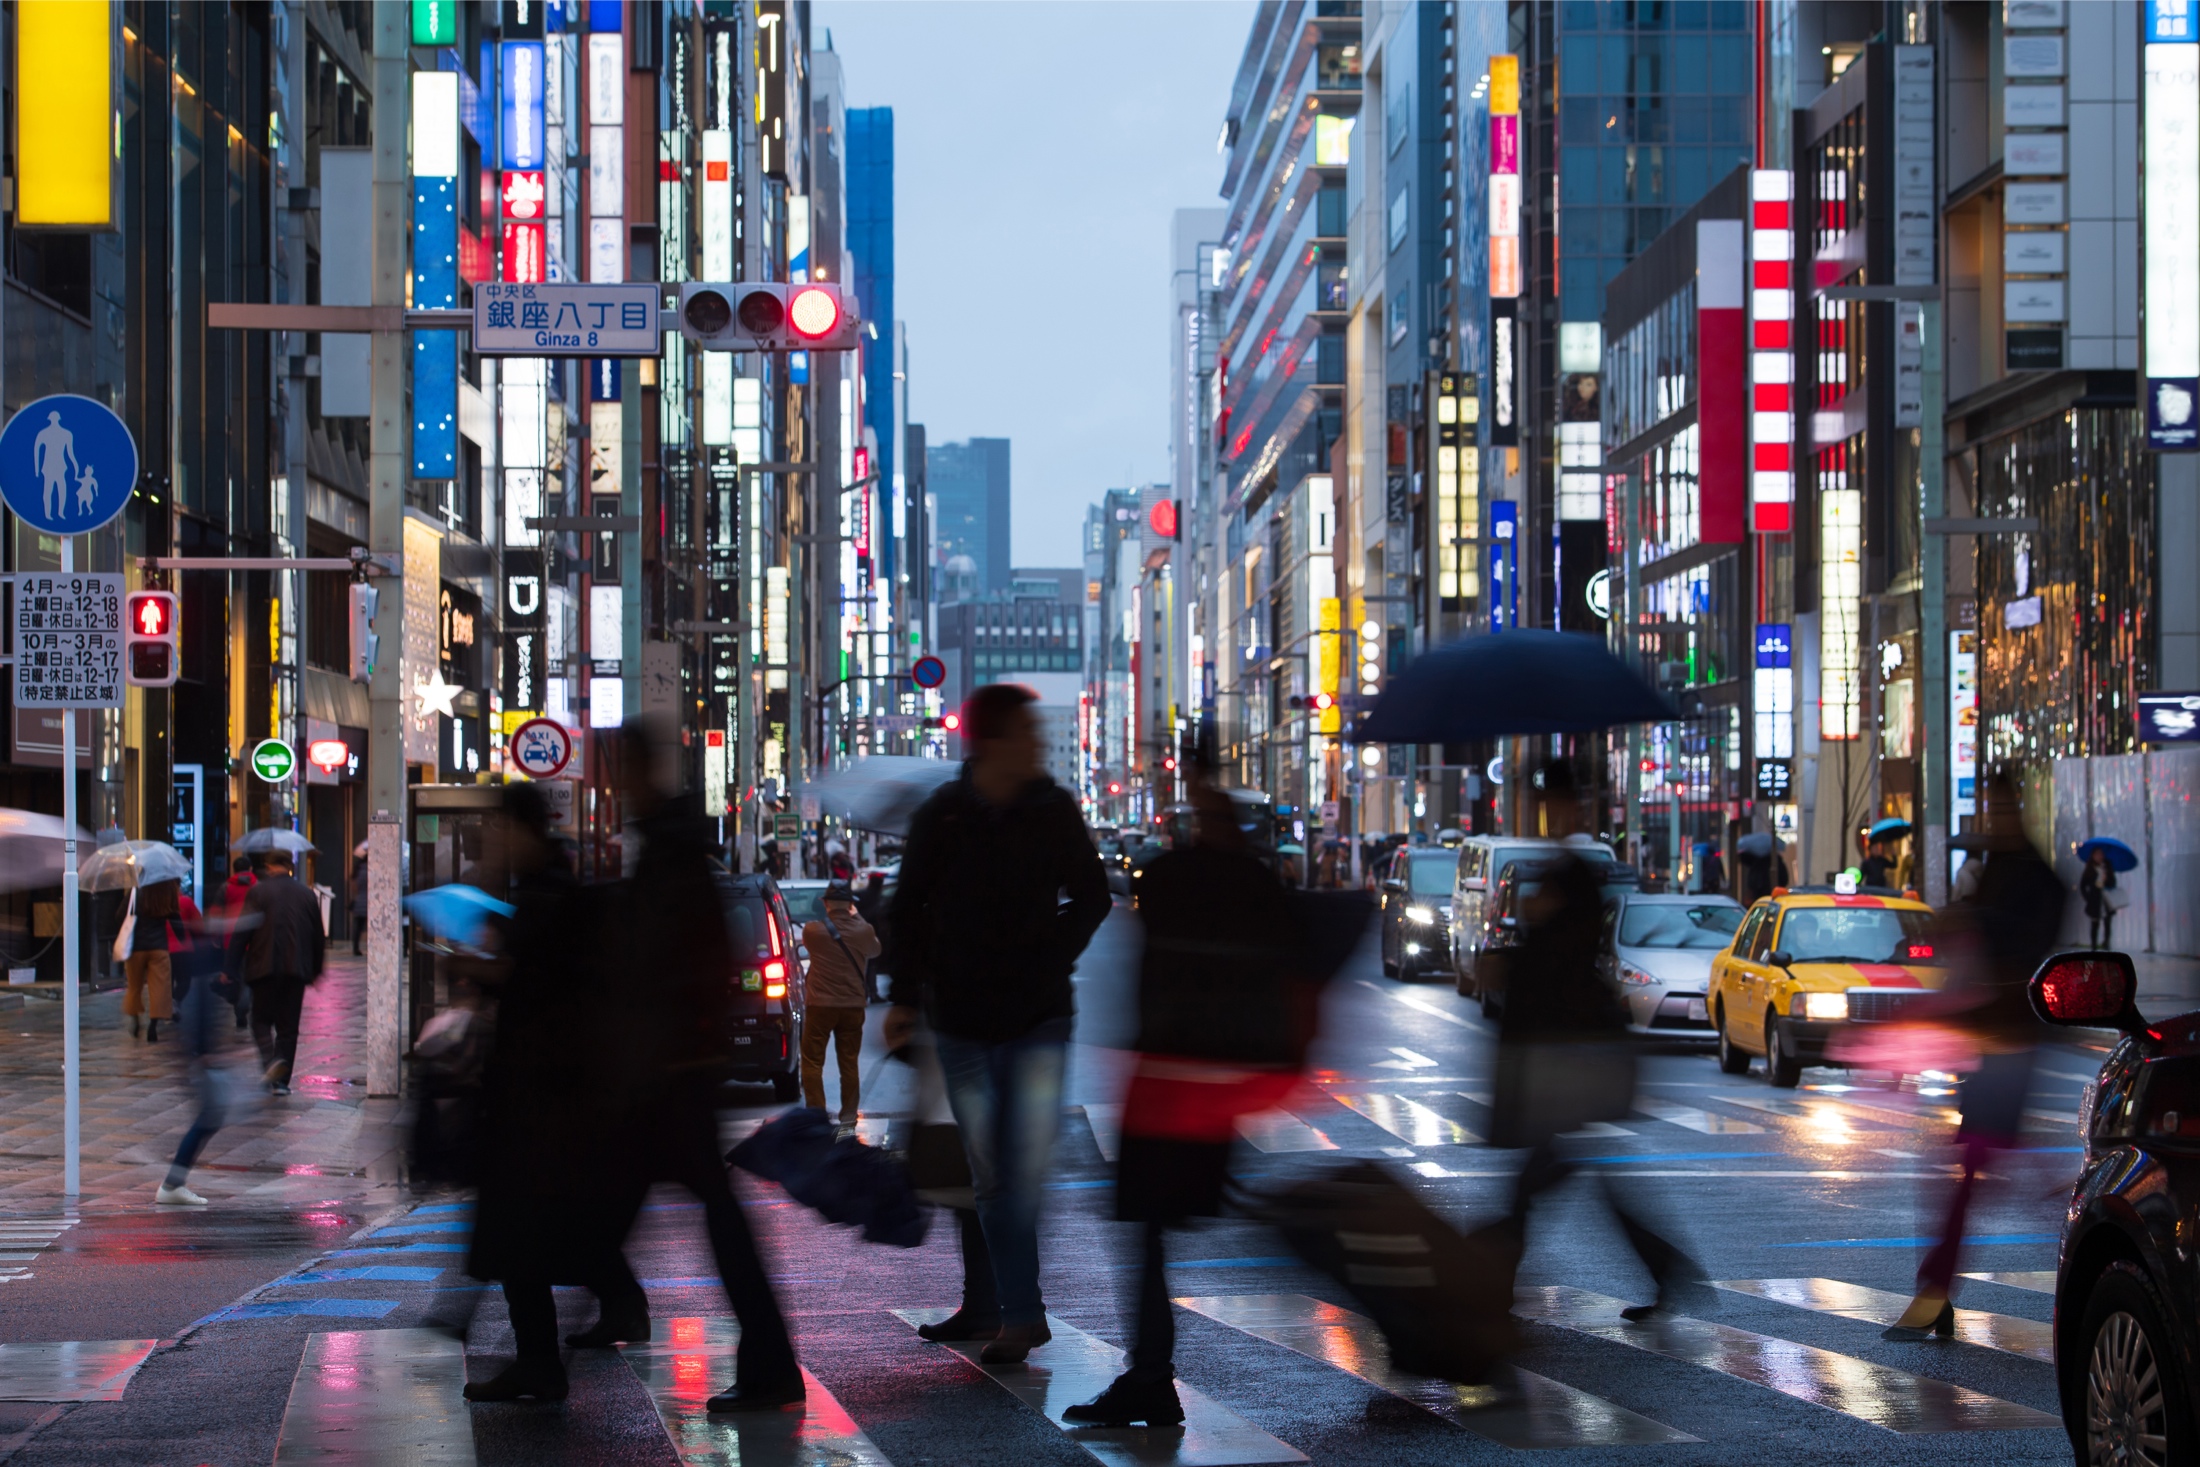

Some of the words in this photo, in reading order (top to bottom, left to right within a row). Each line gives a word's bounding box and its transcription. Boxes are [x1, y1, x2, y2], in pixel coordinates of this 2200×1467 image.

[487, 284, 537, 299] 中央区
[487, 301, 647, 330] 銀座八丁目
[535, 331, 580, 347] Ginza
[587, 332, 599, 347] 8
[20, 596, 118, 612] 土曜日は12-18
[20, 651, 119, 667] 土曜日は12-17
[20, 685, 119, 701] (特定禁止区域)
[525, 731, 549, 740] TAXI
